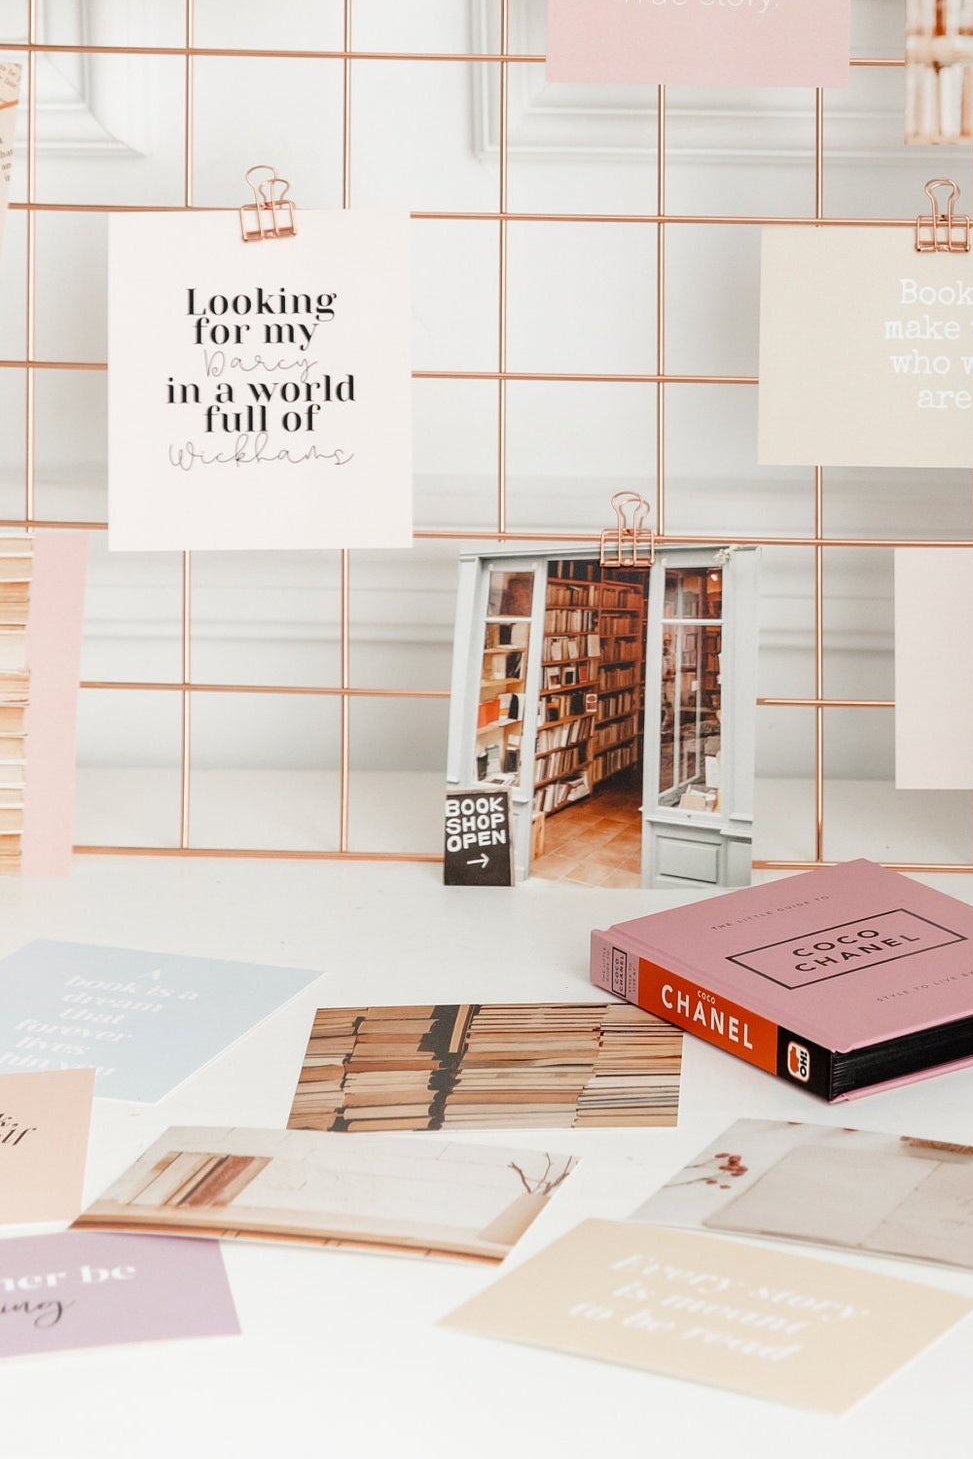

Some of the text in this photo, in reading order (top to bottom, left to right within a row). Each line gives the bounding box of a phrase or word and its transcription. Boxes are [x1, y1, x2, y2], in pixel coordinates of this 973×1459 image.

[186, 287, 337, 322] Looking
[193, 317, 318, 351] for my
[884, 314, 961, 341] make
[203, 349, 318, 383] Darcy
[889, 348, 950, 375] who
[166, 374, 356, 404] in a world
[918, 388, 972, 410] are
[204, 404, 321, 433] full of
[445, 797, 504, 817] BOOK
[446, 813, 505, 835] SHOP
[447, 829, 507, 852] OPEN
[793, 929, 879, 957] COCO
[795, 934, 920, 972] CHANEL
[63, 974, 137, 994] book
[145, 985, 176, 998] is
[697, 990, 716, 1004] COCO
[59, 1007, 127, 1025] that
[60, 992, 164, 1013] dream
[660, 984, 753, 1050] CHANEL
[80, 1264, 136, 1284] be
